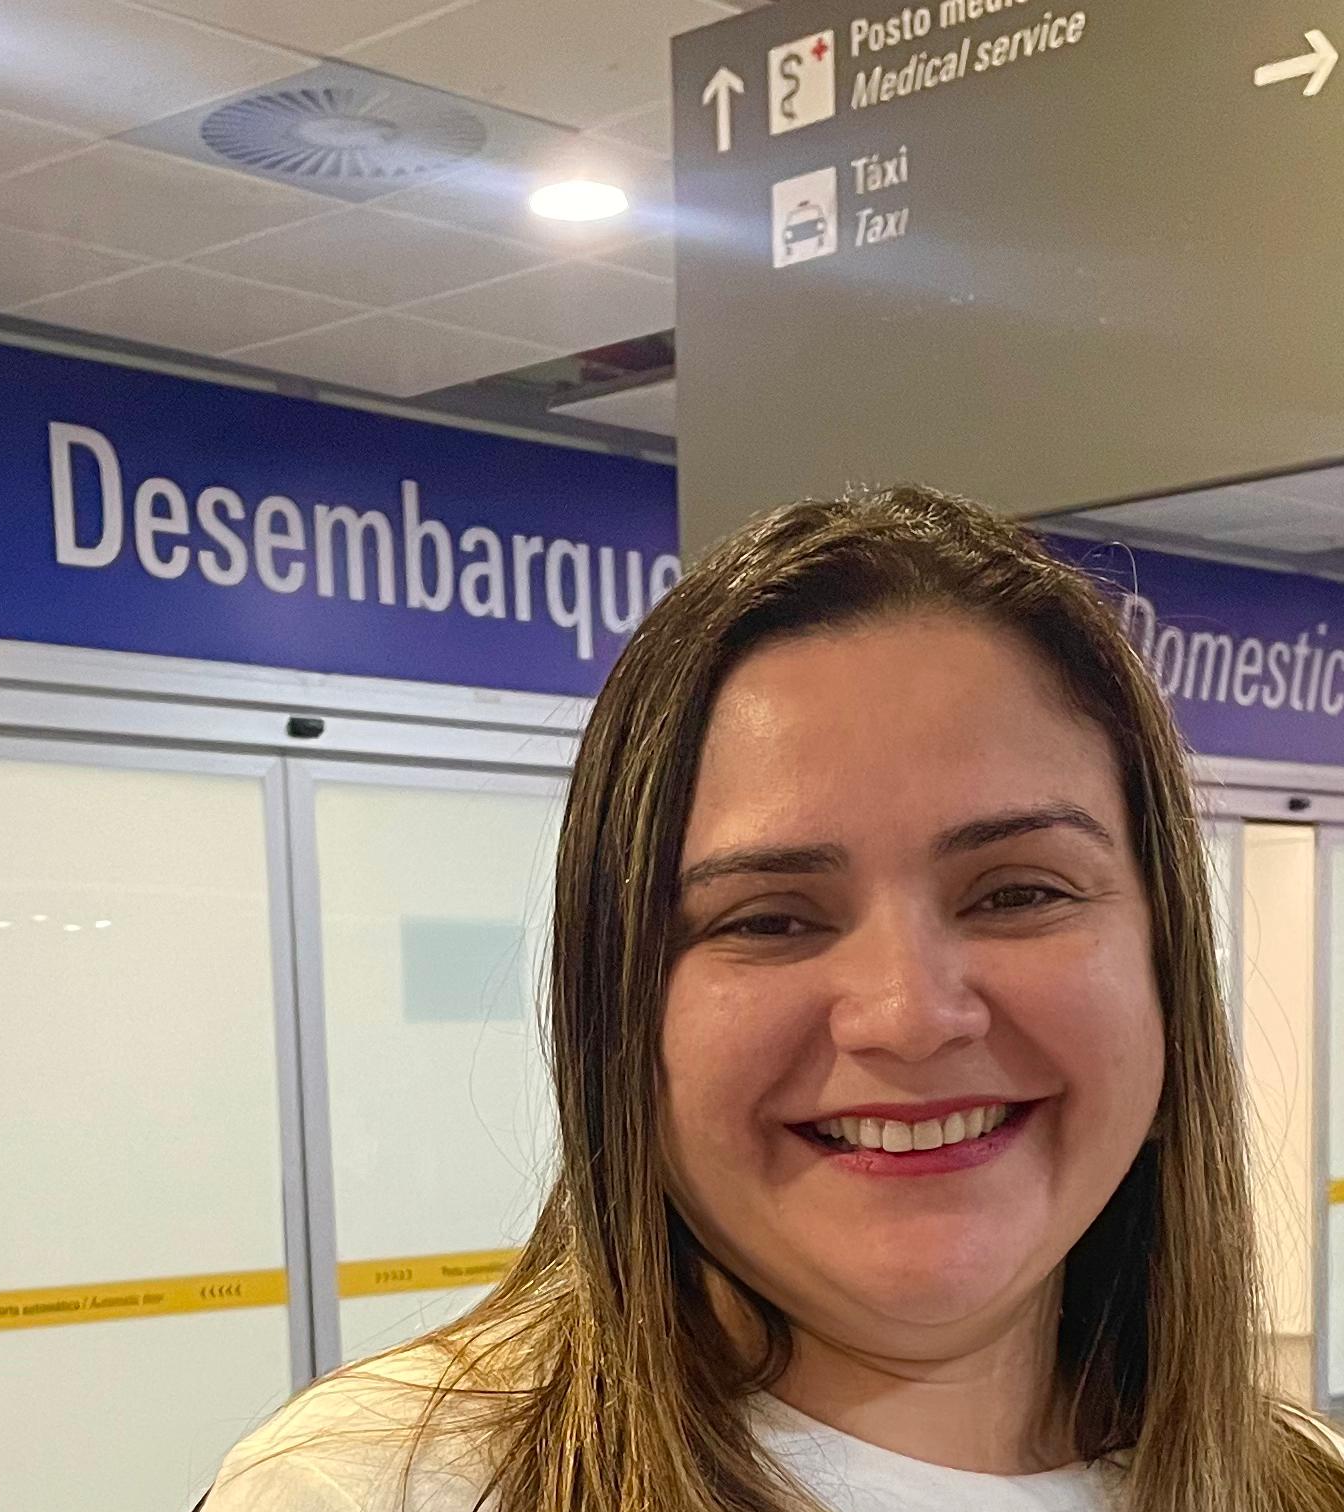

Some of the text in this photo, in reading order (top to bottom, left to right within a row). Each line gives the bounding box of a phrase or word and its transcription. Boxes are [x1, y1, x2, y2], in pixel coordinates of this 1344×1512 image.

[851, 8, 931, 57] Posto
[851, 37, 971, 110] Medical
[974, 11, 1086, 71] service
[851, 144, 908, 194] Táxi
[855, 208, 909, 247] Taxi
[49, 421, 682, 659] Desembarque
